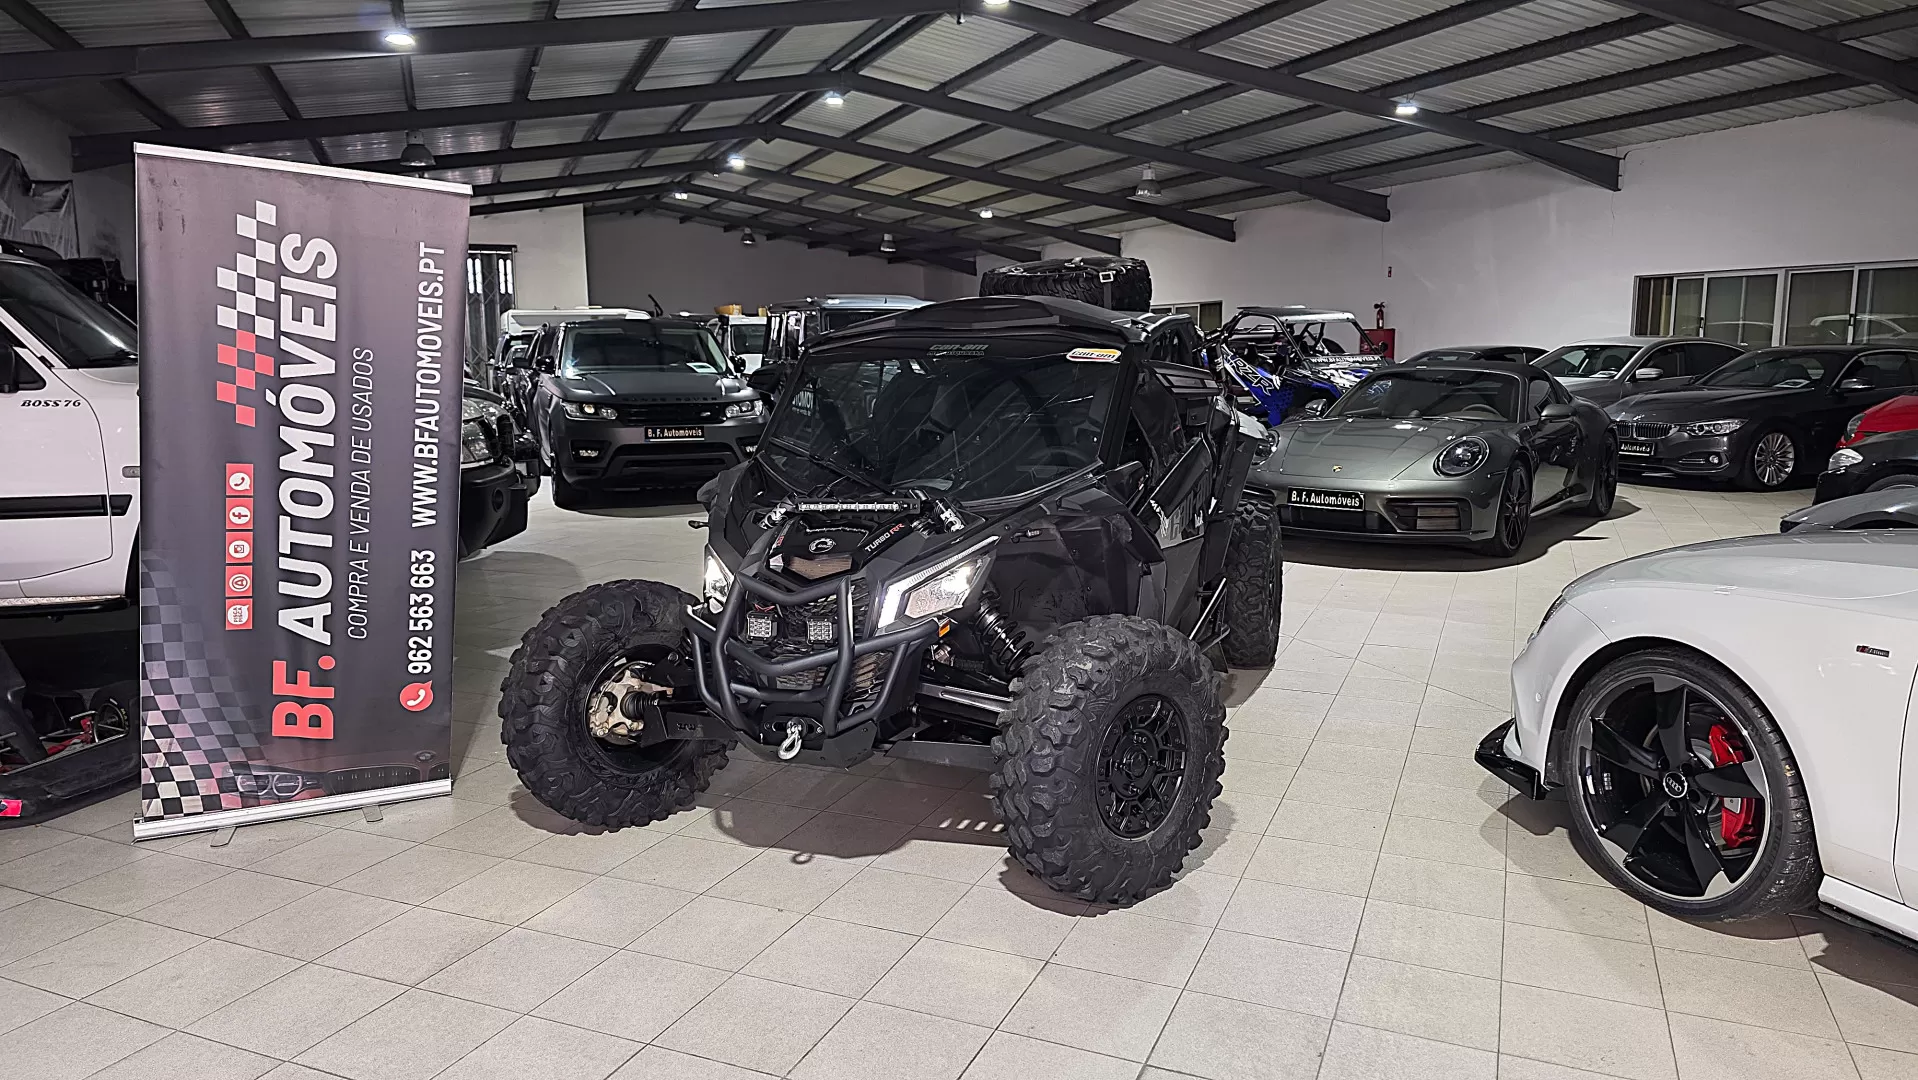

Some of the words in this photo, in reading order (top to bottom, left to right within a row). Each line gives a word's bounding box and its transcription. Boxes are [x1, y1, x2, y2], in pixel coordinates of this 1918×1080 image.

[20, 399, 61, 407] BOSS
[64, 399, 81, 407] 76
[352, 347, 374, 432] USADOS
[412, 241, 445, 528] WWW.BFAUTOMOVEIS.PT
[265, 233, 338, 646] AUTOMÓVEIS
[351, 436, 372, 464] DE
[648, 429, 656, 438] B.
[656, 428, 663, 438] F.
[664, 427, 702, 438] Automóveis
[350, 470, 371, 536] VENDA
[1291, 490, 1300, 502] B.
[1301, 491, 1309, 503] F.
[1310, 493, 1360, 507] Automóveis
[350, 539, 370, 554] E
[865, 532, 891, 552] TURBO
[889, 523, 905, 536] RR
[410, 549, 436, 588] 663
[348, 559, 369, 640] COMPRA
[409, 593, 434, 631] 563
[407, 636, 433, 674] 962
[271, 655, 336, 740] BF.
